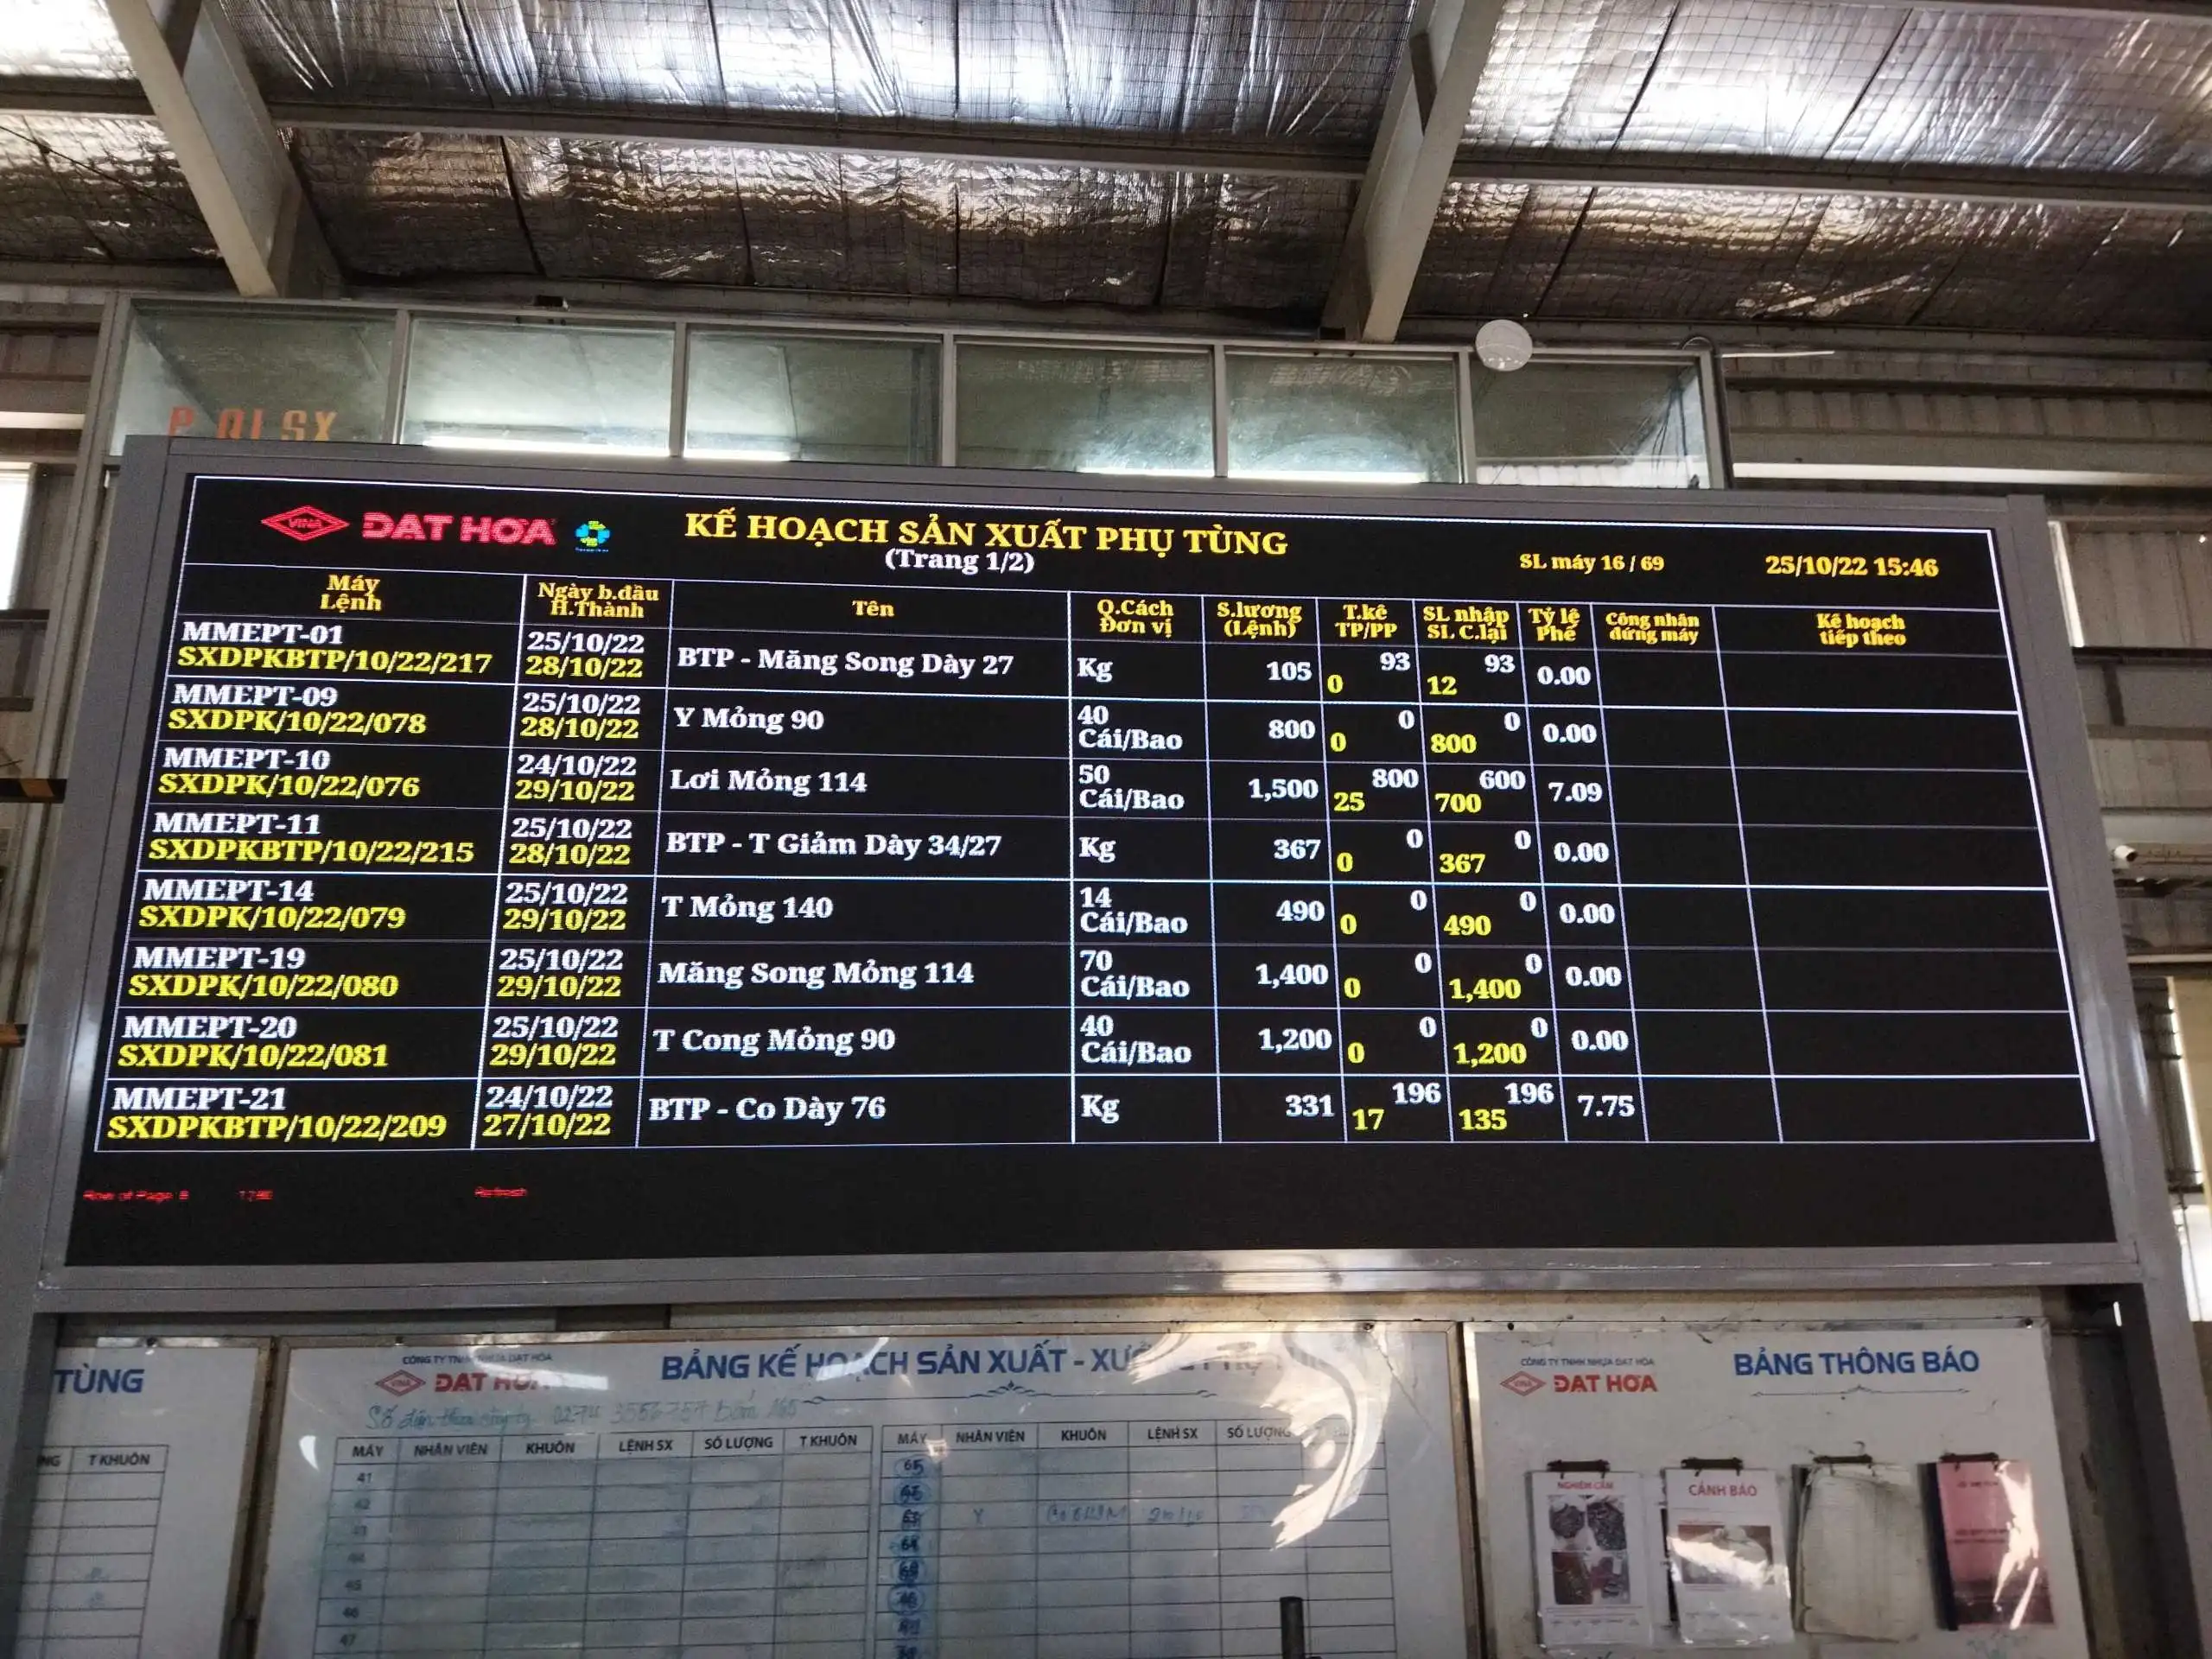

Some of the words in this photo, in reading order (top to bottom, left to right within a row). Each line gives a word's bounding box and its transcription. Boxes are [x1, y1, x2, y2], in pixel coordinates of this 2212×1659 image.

[685, 507, 736, 537] KẾ
[747, 516, 888, 547] HOẠCH
[899, 514, 976, 545] SẢN
[985, 518, 1087, 549] XUẤT
[1096, 527, 1174, 557] PHỤ
[1183, 524, 1287, 555] TÙNG
[886, 548, 979, 575] (Trang
[986, 552, 1034, 574] 1/2)
[1520, 554, 1547, 569] SL
[1552, 555, 1596, 574] máy
[1601, 556, 1624, 569] 16
[1630, 556, 1636, 572] /
[1641, 556, 1664, 570] 69
[1766, 556, 1868, 577] 25/10/22
[1874, 557, 1939, 576] 15:46
[327, 575, 380, 596] Máy
[537, 582, 594, 601] Ngày
[321, 590, 382, 612] Lệnh
[550, 600, 645, 618] H.Thành
[852, 600, 895, 619] Tên
[1097, 599, 1174, 620] Q.Cách
[1423, 607, 1451, 622] SL
[1454, 607, 1510, 628] nhập
[1560, 607, 1581, 627] lệ
[1846, 613, 1906, 631] hoạch
[181, 621, 342, 645] MMEPT-01
[1100, 619, 1146, 634] Đơn
[1152, 619, 1173, 638] vị
[1224, 620, 1297, 639] (Lệnh)
[1335, 622, 1398, 639] TP/PP
[1427, 625, 1455, 639] SL
[1460, 625, 1508, 645] C.lại
[1661, 628, 1700, 645] máy
[1820, 628, 1859, 648] tiếp
[1862, 632, 1907, 645] theo
[527, 632, 644, 656] 25/10/22
[178, 646, 493, 674] SXDPKBTP/10/22/217
[525, 656, 643, 680] 28/10/22
[677, 647, 734, 667] BTP
[758, 650, 838, 676] Măng
[845, 652, 914, 677] Song
[921, 654, 976, 679] Dày
[983, 656, 1014, 674] 27
[1267, 662, 1312, 681] 105
[171, 684, 338, 707] MMEPT-09
[522, 692, 640, 716] 25/10/22
[168, 709, 426, 735] SXDPK/10/22/078
[520, 716, 639, 741] 28/10/22
[674, 708, 695, 727] Y
[702, 706, 785, 734] Mỏng
[791, 710, 823, 729] 90
[1268, 720, 1315, 739] 800
[162, 747, 330, 770] MMEPT-10
[517, 754, 636, 778] 24/10/22
[158, 773, 419, 798] SXDPK/10/22/076
[515, 779, 634, 804] 29/10/22
[671, 769, 720, 790] Lơi
[728, 768, 811, 797] Mỏng
[818, 772, 868, 792] 114
[1249, 779, 1319, 802] 1,500
[152, 812, 320, 834] MMEPT-11
[511, 817, 632, 842] 25/10/22
[149, 839, 474, 865] SXDPKBTP/10/22/215
[509, 843, 630, 868] 28/10/22
[666, 832, 725, 853] BTP
[749, 833, 771, 854] T
[778, 831, 856, 855] Giảm
[864, 834, 922, 861] Dày
[928, 835, 1001, 858] 34/27
[1274, 839, 1321, 859] 367
[143, 879, 315, 901] MMEPT-14
[505, 881, 627, 907] 25/10/22
[139, 906, 405, 931] SXDPK/10/22/079
[662, 896, 683, 917] T
[690, 893, 775, 924] Mỏng
[783, 897, 833, 918] 140
[1276, 900, 1325, 921] 490
[503, 908, 626, 933] 29/10/22
[112, 1088, 285, 1110] MMEPT-21
[485, 1084, 613, 1111] 24/10/22
[1286, 1095, 1334, 1116] 331
[649, 1098, 710, 1120] BTP
[736, 1098, 775, 1120] Co
[784, 1096, 844, 1126] Dày
[851, 1096, 886, 1119] 76
[108, 1115, 447, 1141] SXDPKBTP/10/22/209
[482, 1113, 611, 1140] 27/10/22
[661, 1350, 750, 1381] BẢNG
[759, 1343, 800, 1379] KẾ
[916, 1344, 982, 1377] SẢN
[988, 1340, 1067, 1376] XUẤT
[1733, 1346, 1814, 1376] BẢNG
[1818, 1346, 1916, 1375] THÔNG
[1922, 1345, 1980, 1373] BÁO
[54, 1363, 145, 1394] TÙNG
[704, 1436, 723, 1449] SỐ
[726, 1437, 774, 1452] LƯỢNG
[810, 1433, 858, 1446] KHUÔN
[956, 1431, 993, 1444] NHÂN
[995, 1429, 1026, 1442] VIÊN
[1061, 1428, 1108, 1441] KHUÔN
[1147, 1427, 1180, 1443] LỆNH
[1182, 1427, 1198, 1440] SX
[1227, 1426, 1244, 1440] SỐ
[353, 1444, 384, 1458] MÁY
[415, 1443, 453, 1457] NHÂN
[455, 1443, 488, 1456] VIÊN
[525, 1441, 575, 1455] KHUÔN
[619, 1439, 654, 1455] LỆNH
[656, 1440, 673, 1452] SX
[99, 1452, 150, 1466] KHUÔN
